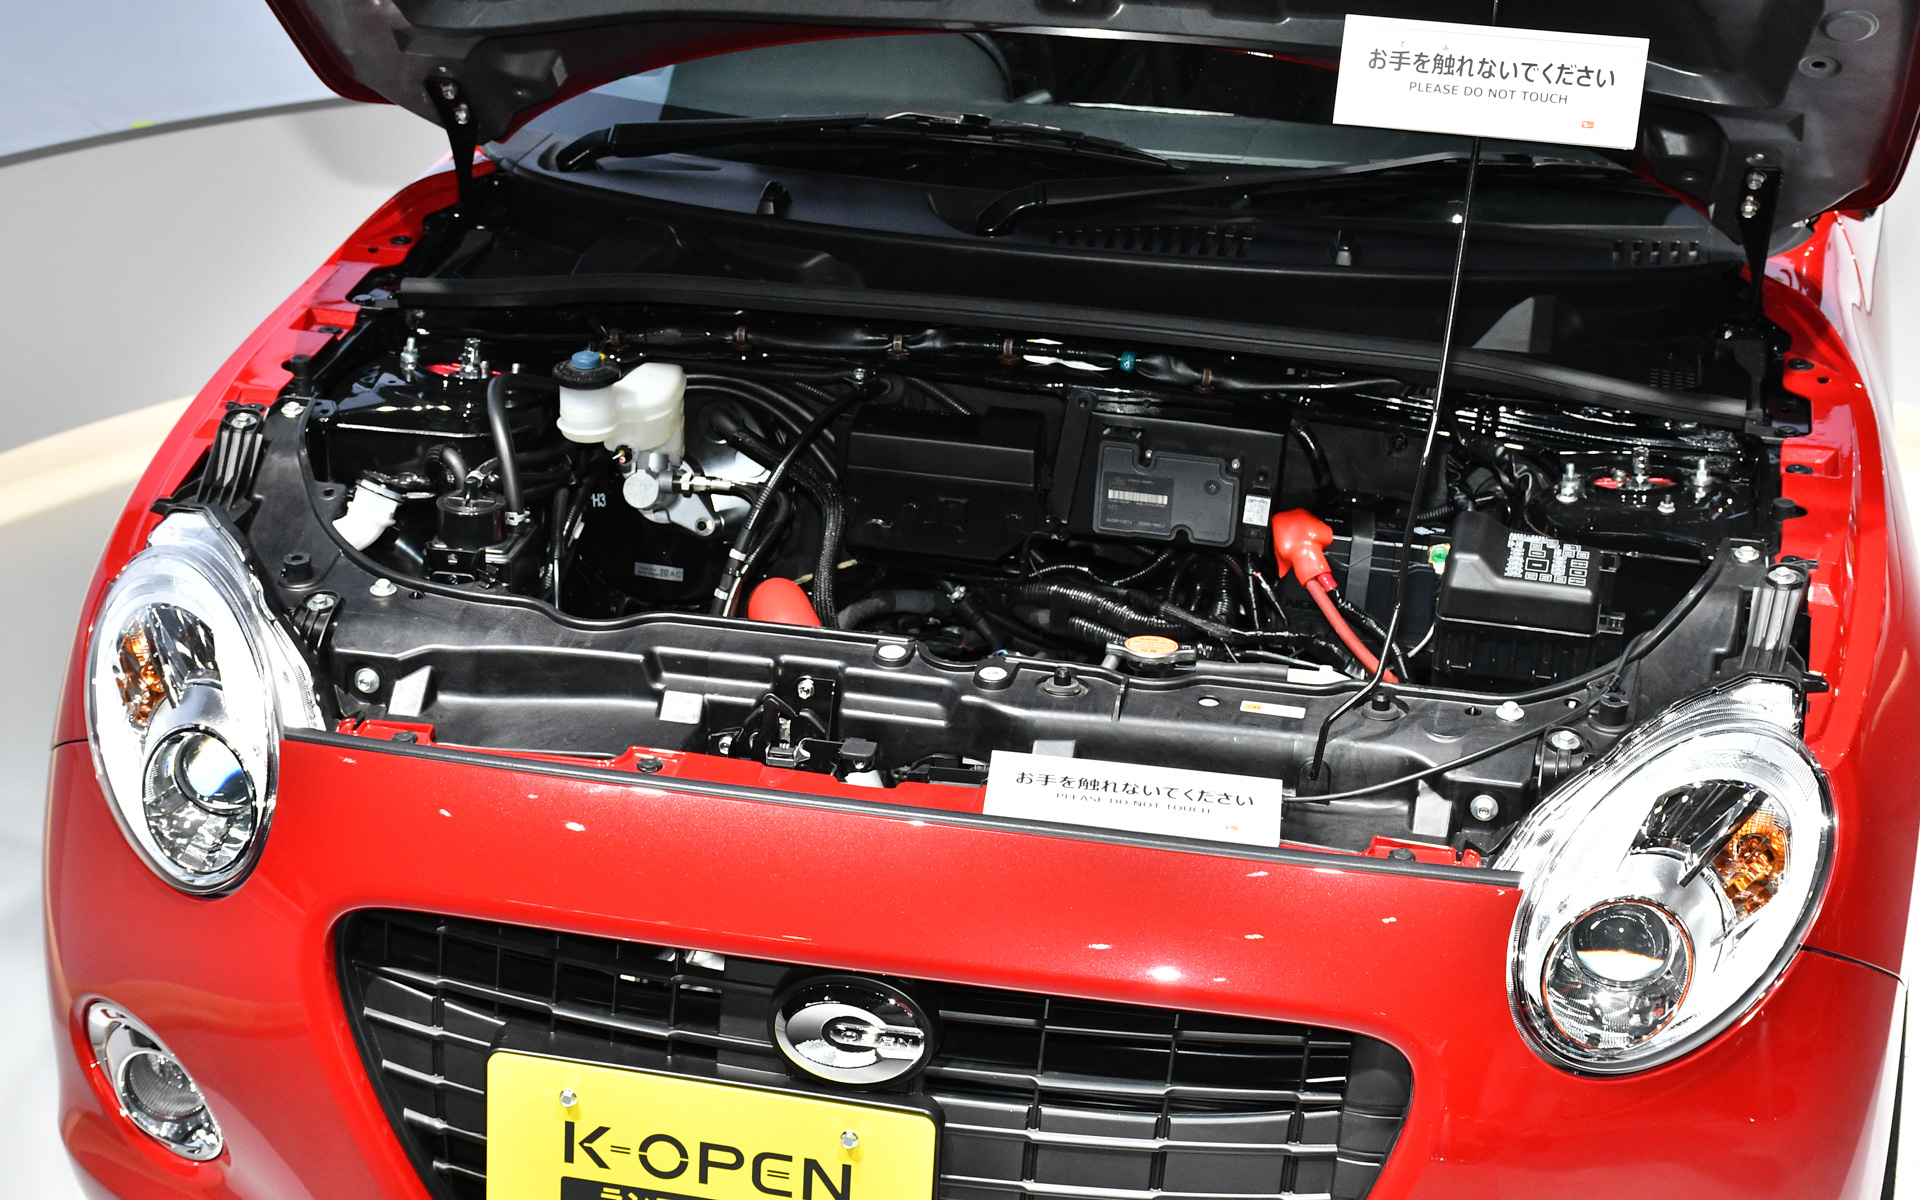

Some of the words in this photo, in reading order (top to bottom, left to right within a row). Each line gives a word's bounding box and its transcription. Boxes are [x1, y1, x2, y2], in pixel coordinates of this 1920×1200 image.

[1368, 48, 1615, 88] お手を触れないでください
[1408, 81, 1459, 96] PLEASE
[1463, 86, 1483, 98] DO
[1488, 88, 1516, 101] NOT
[1521, 91, 1569, 105] TOUCH
[1015, 771, 1254, 807] お手を触れないでください
